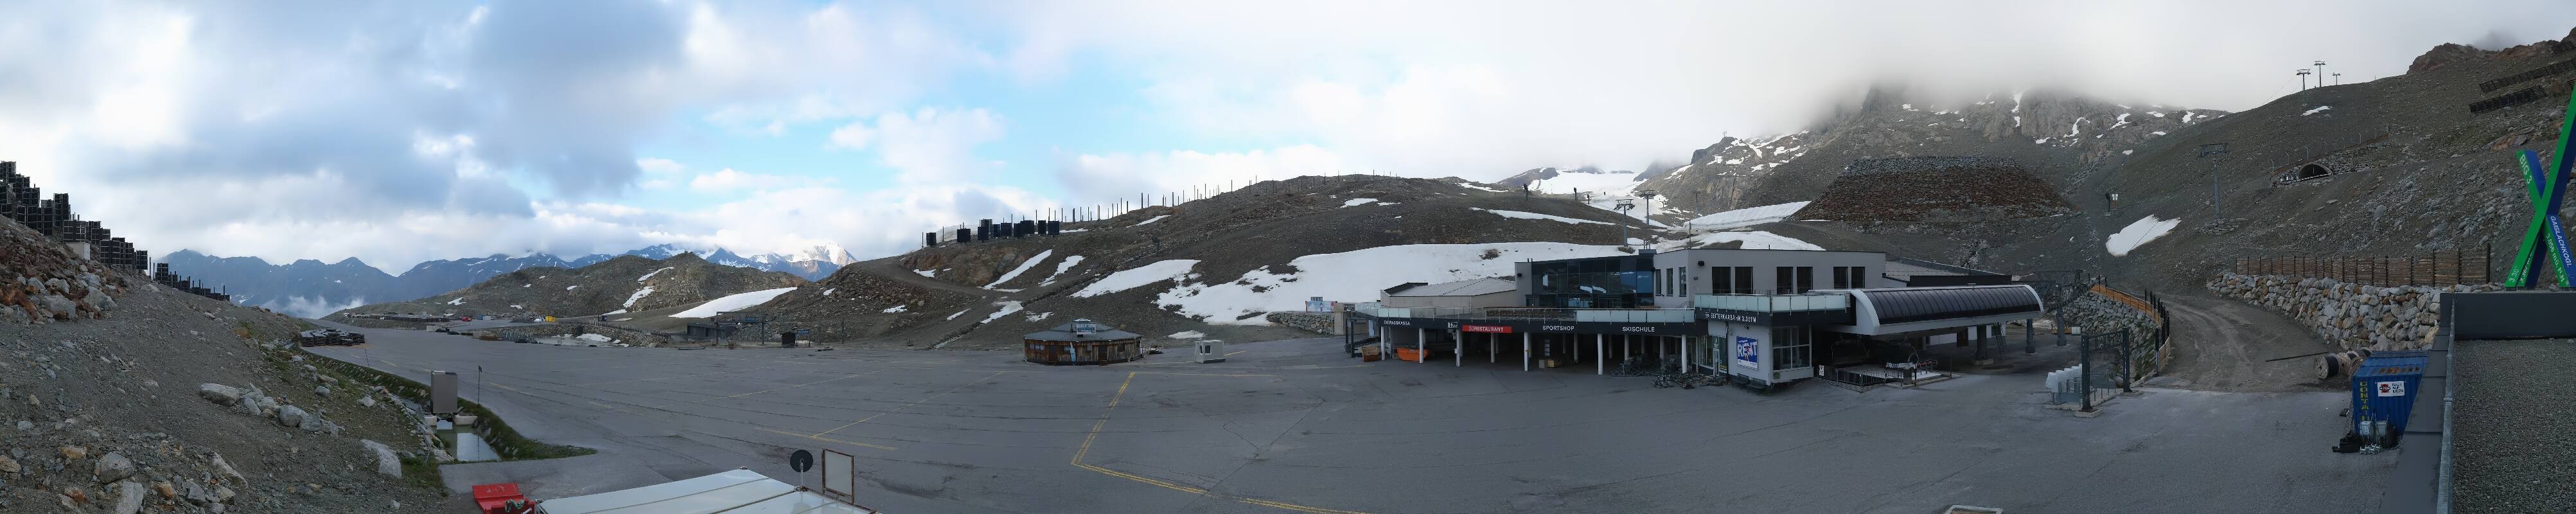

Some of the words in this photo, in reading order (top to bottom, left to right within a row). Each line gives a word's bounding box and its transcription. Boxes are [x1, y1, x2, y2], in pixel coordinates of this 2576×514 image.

[2519, 154, 2529, 175] BIG
[2526, 175, 2532, 184] 3
[2546, 233, 2555, 253] 3.058
[2550, 216, 2572, 267] GAISLACHKOGL
[2509, 267, 2519, 282] 3.30
[1737, 342, 1758, 357] RENT
